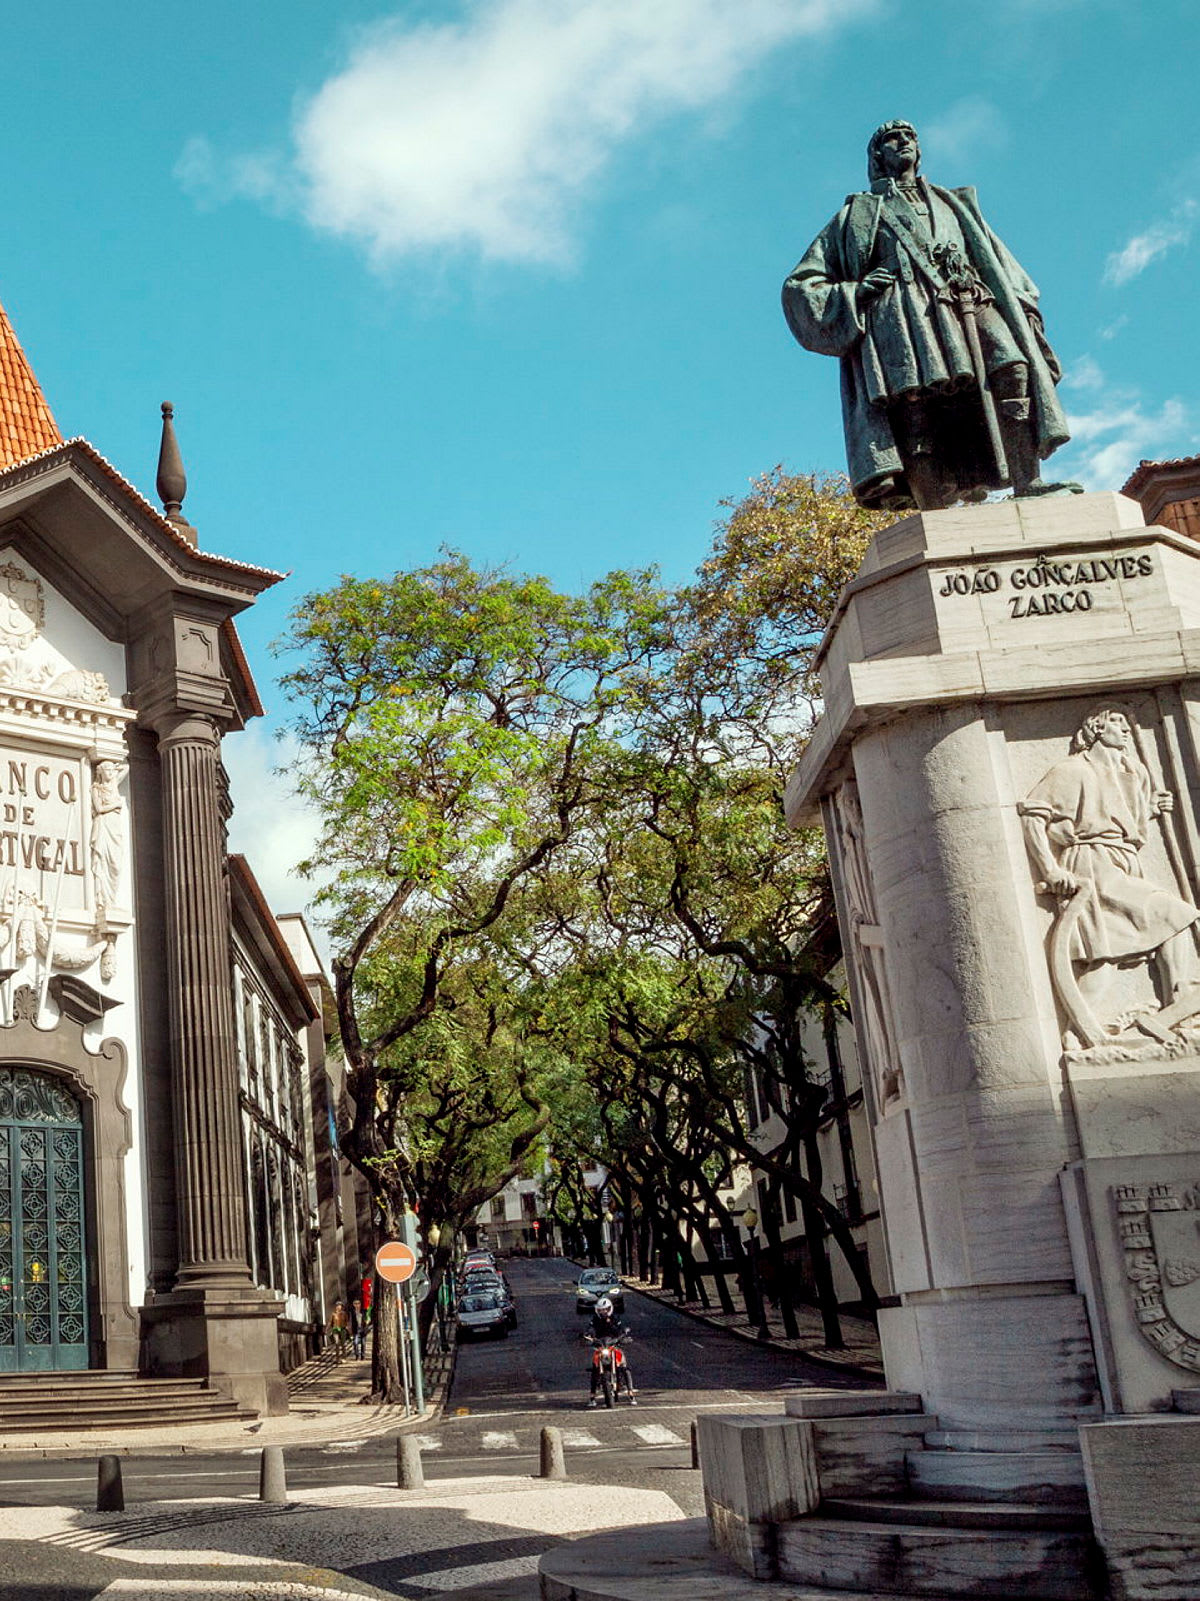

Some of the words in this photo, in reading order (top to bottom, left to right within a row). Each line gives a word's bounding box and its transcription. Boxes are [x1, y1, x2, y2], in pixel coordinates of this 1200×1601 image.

[939, 566, 1002, 597] JOÃO
[1010, 555, 1154, 590] GONÇALVES
[1008, 589, 1093, 618] ZARCO
[3, 803, 35, 825] DE
